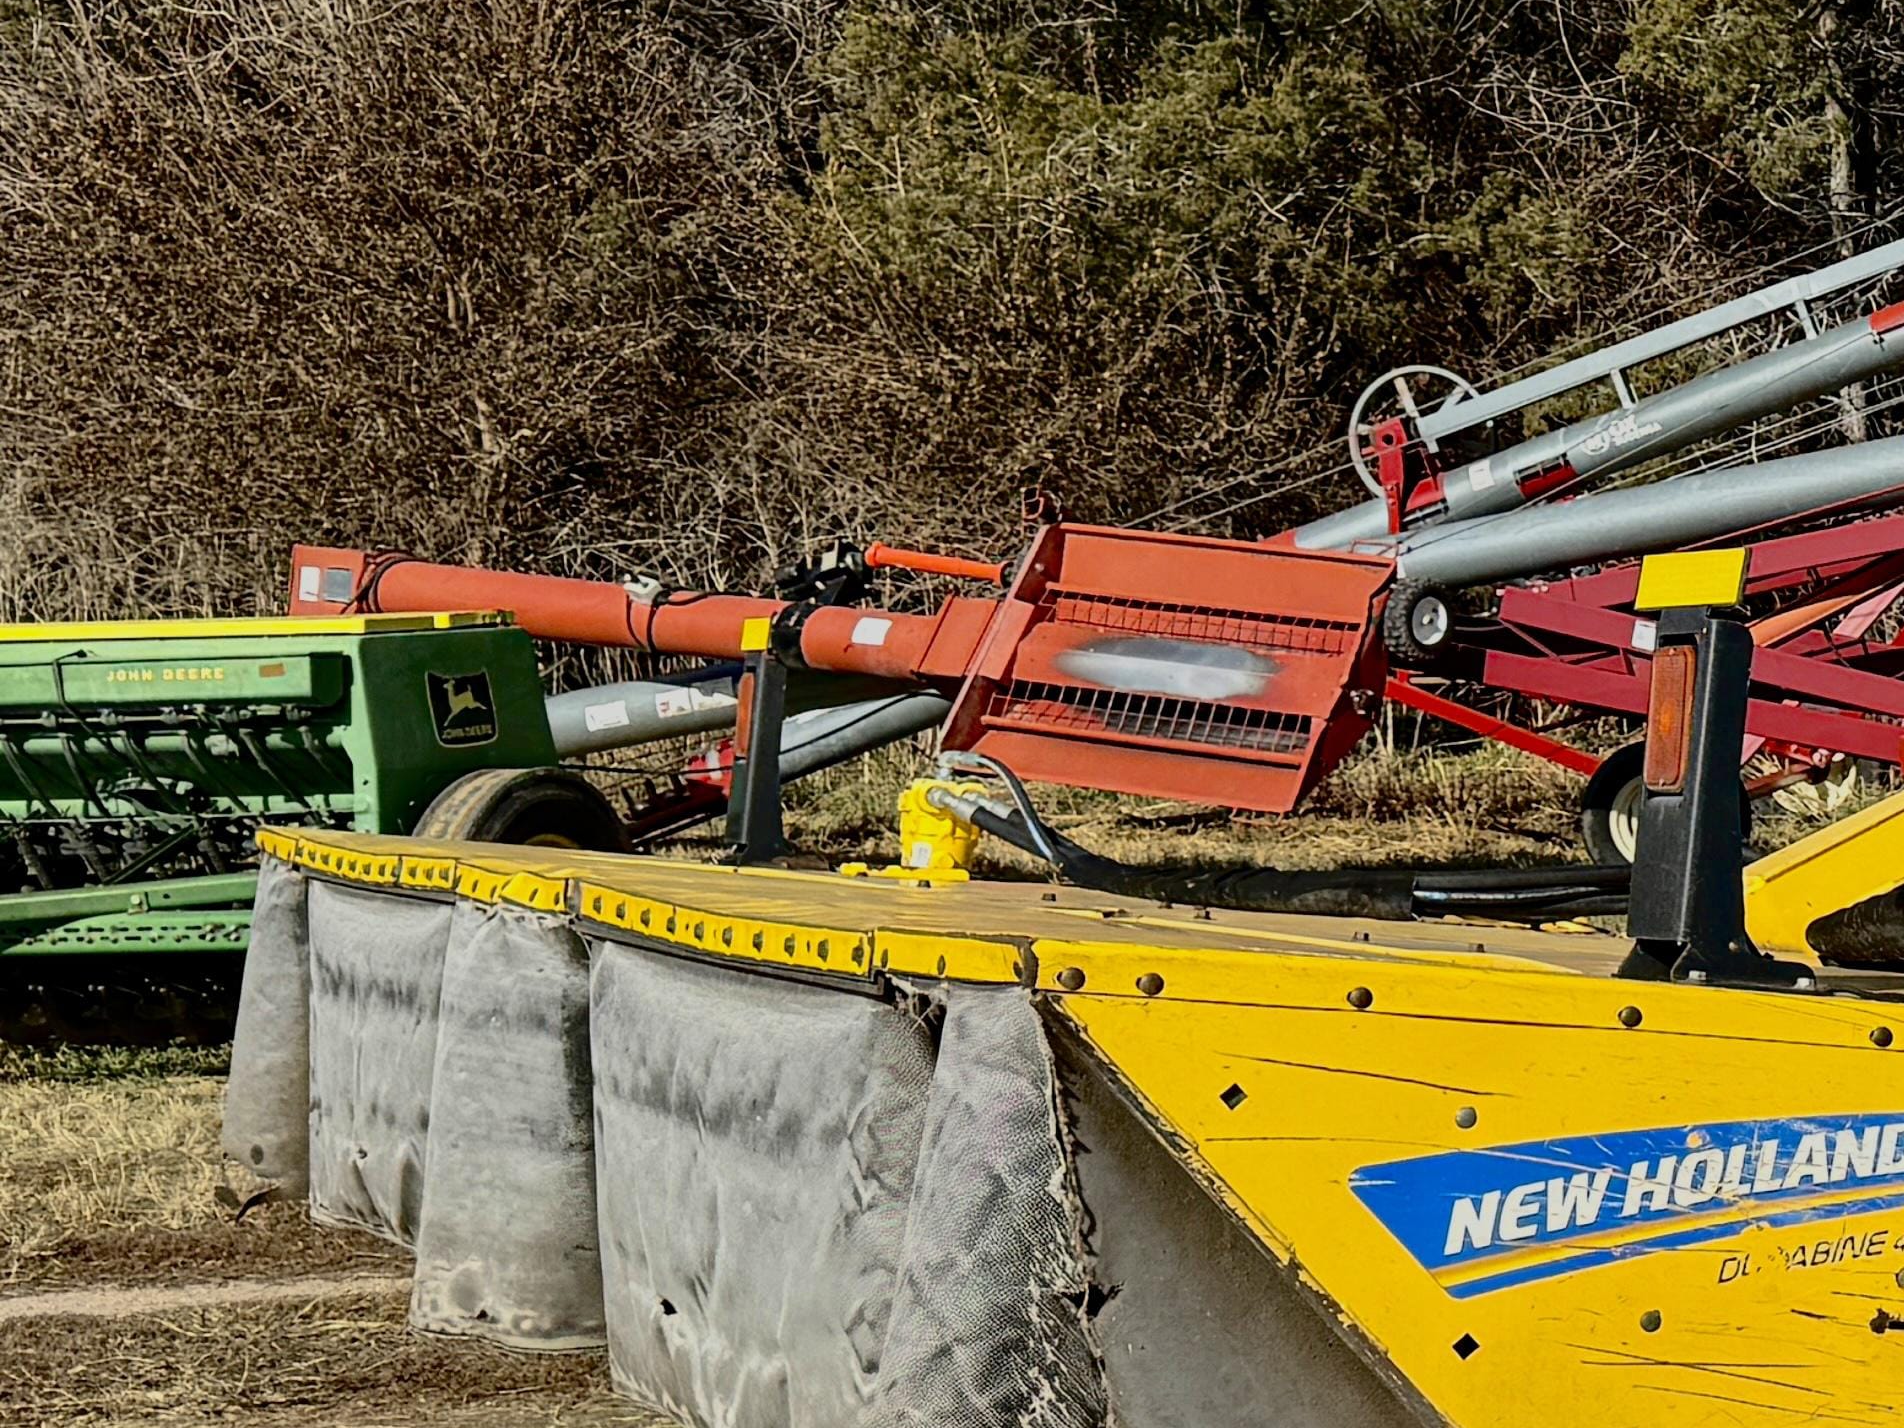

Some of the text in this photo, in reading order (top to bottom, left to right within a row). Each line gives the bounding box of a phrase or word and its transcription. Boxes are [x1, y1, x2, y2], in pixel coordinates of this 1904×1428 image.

[107, 667, 224, 682] JOHN DEERE
[1443, 1169, 1613, 1256] NEW
